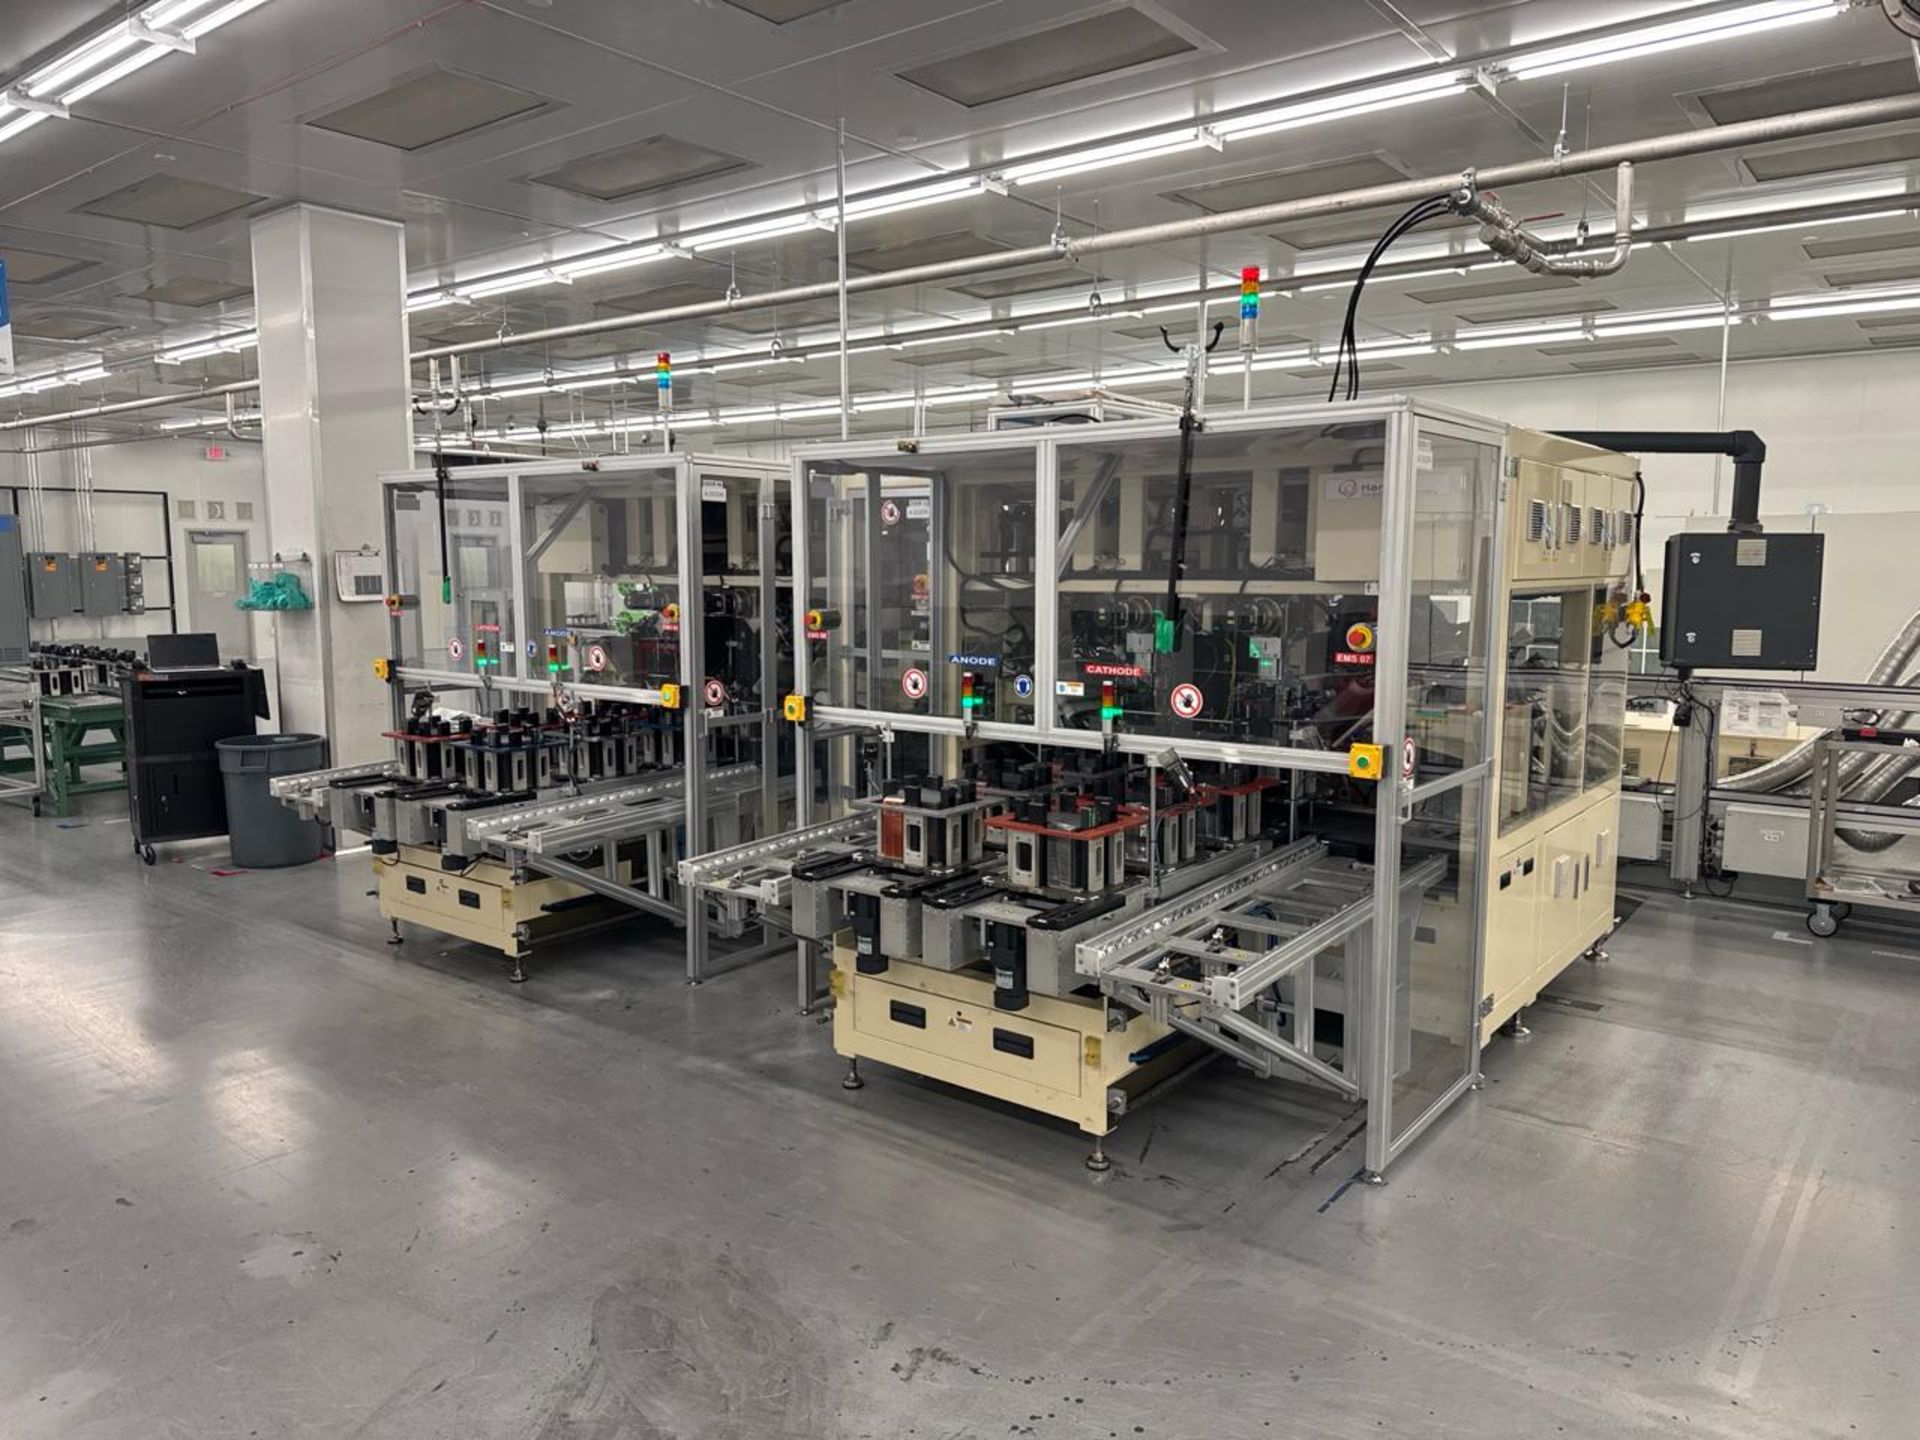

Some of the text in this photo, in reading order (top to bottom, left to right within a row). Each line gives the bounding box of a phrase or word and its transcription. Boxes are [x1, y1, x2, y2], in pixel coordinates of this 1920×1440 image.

[951, 655, 996, 667] ANODE
[1336, 653, 1358, 663] EMS
[1086, 664, 1141, 677] CATHODE
